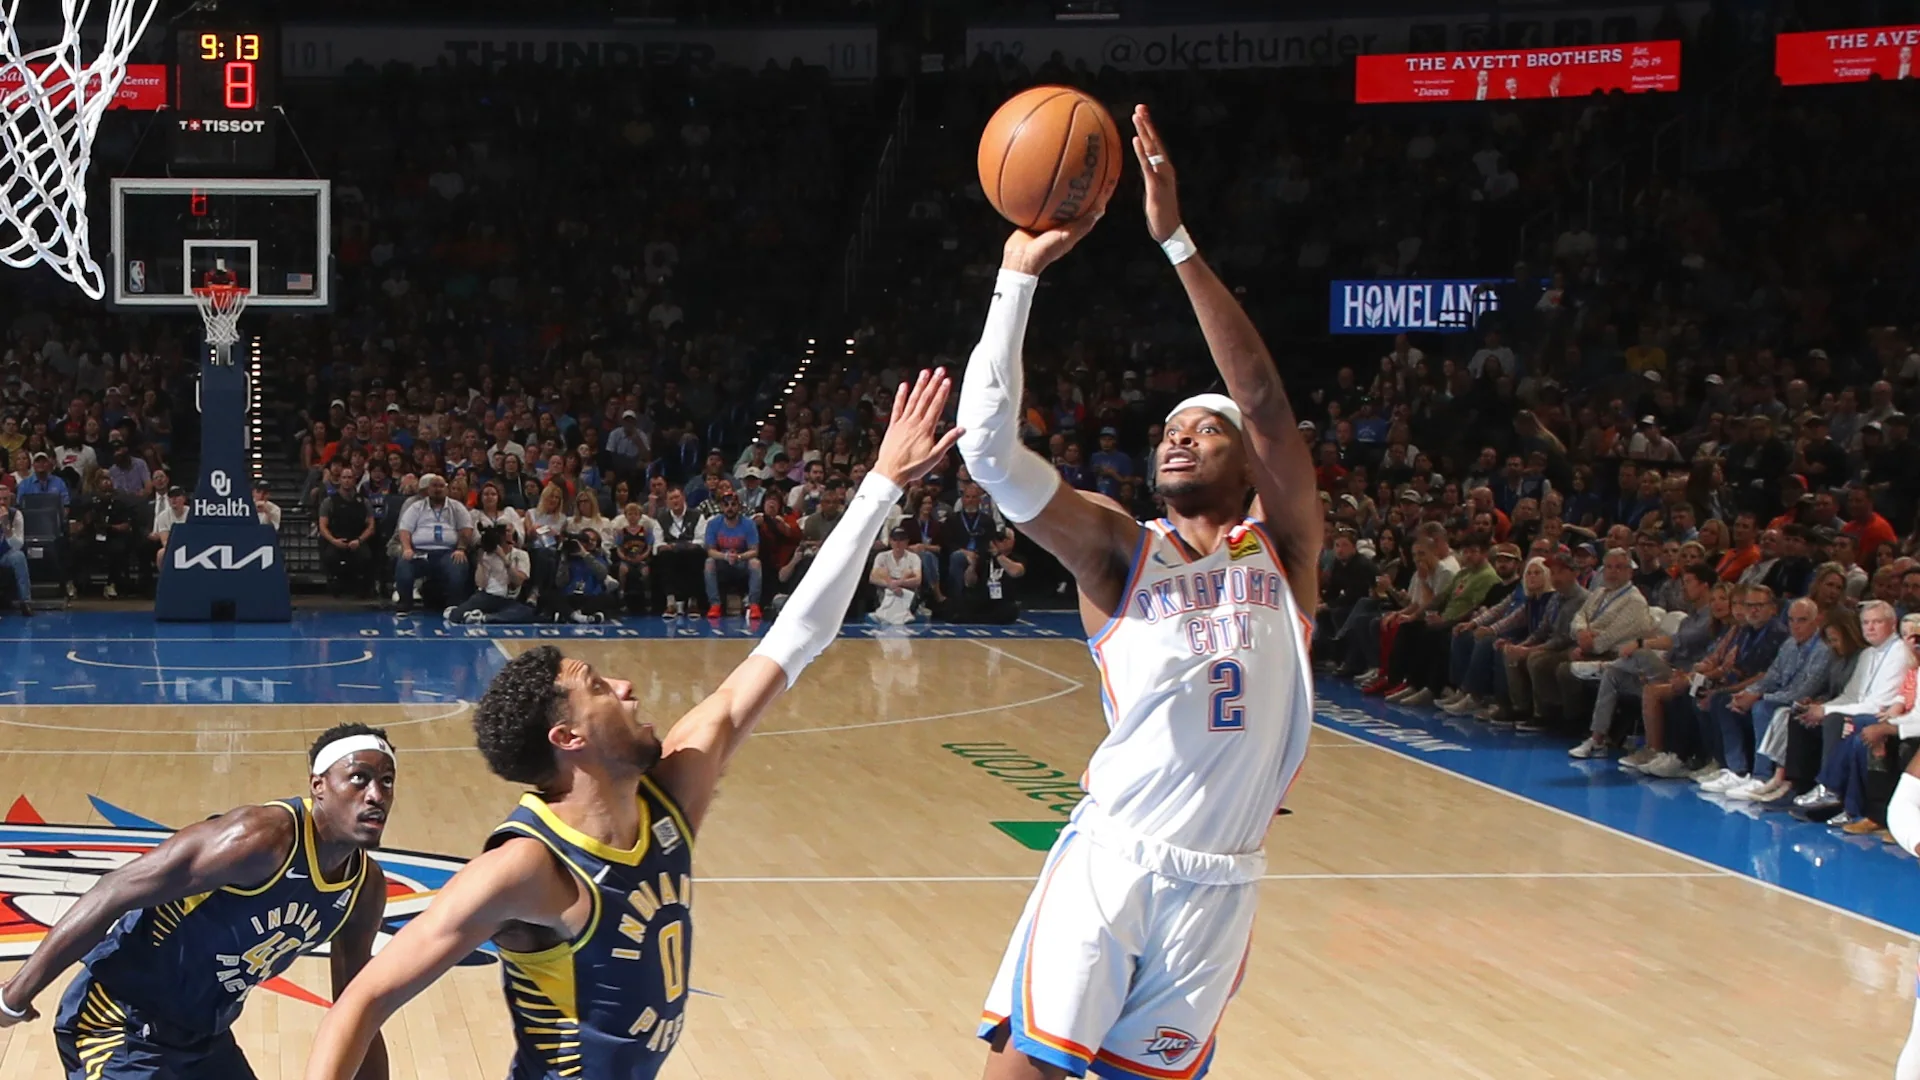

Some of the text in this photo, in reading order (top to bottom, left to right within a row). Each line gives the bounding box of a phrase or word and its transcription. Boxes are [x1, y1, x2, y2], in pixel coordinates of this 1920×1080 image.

[200, 34, 260, 60] 9:13
[1826, 30, 1920, 49] THE AVE
[1406, 48, 1623, 71] THE AVETT BROTHERS
[123, 76, 160, 86] Center
[225, 62, 253, 108] 8
[202, 119, 265, 133] TISSOT
[211, 470, 231, 496] OU
[194, 497, 250, 517] Health
[174, 544, 274, 570] KIA
[1134, 566, 1282, 625] OKLAHOMA
[1185, 611, 1252, 655] CITY
[1208, 657, 1246, 732] 2
[658, 920, 684, 1003] 0
[1148, 1036, 1188, 1052] OKC
